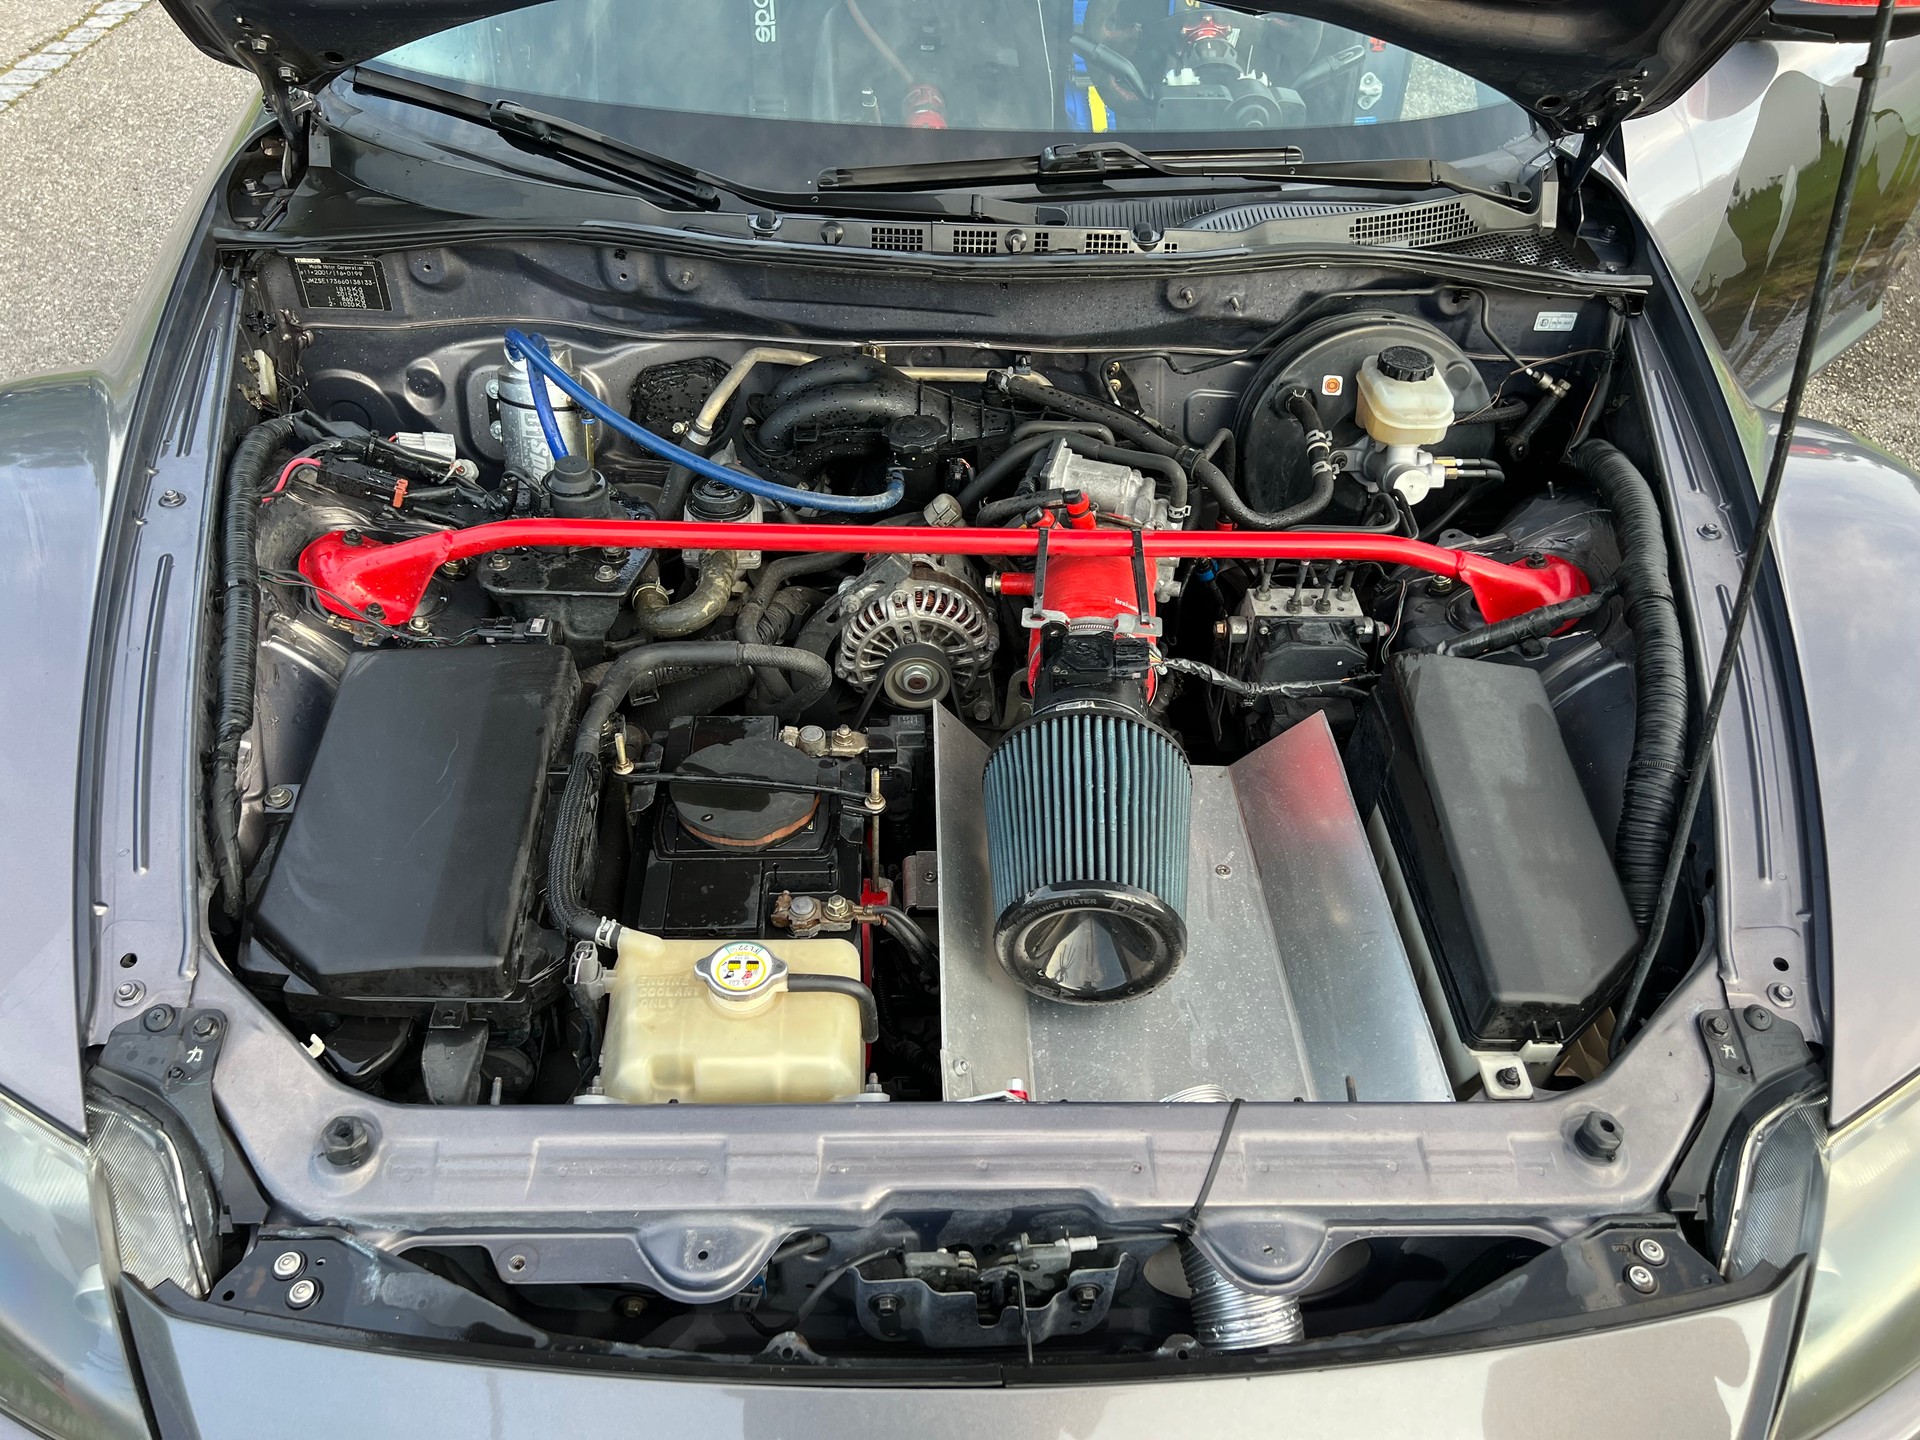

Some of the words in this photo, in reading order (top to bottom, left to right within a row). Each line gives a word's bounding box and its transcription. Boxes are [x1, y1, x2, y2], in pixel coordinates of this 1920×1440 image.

[637, 975, 690, 987] ENGINE
[638, 986, 699, 998] COOLANT
[640, 998, 677, 1009] ONLY
